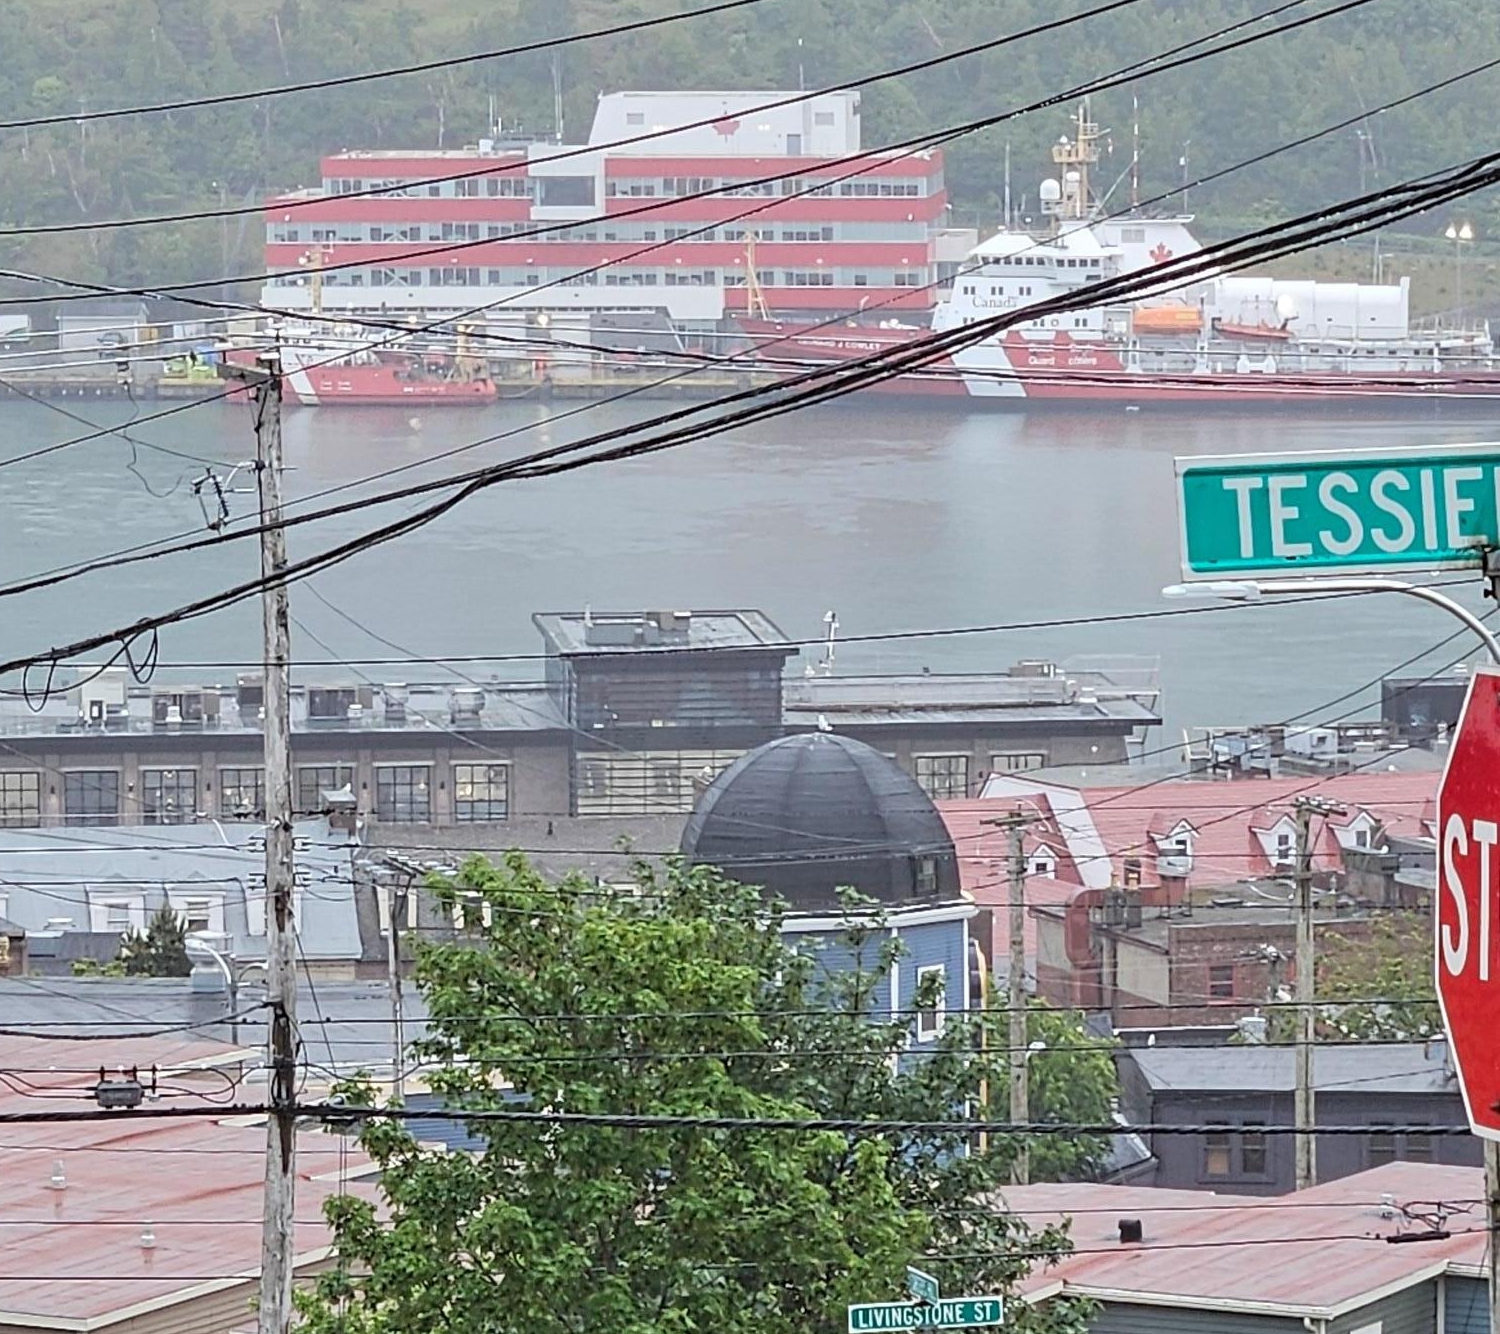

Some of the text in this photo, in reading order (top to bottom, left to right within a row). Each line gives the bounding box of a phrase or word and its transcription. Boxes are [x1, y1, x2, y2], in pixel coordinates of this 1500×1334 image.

[972, 295, 1018, 308] Canada
[1222, 466, 1500, 558] TESSIE
[858, 1302, 993, 1329] LIVINGSTONE ST
